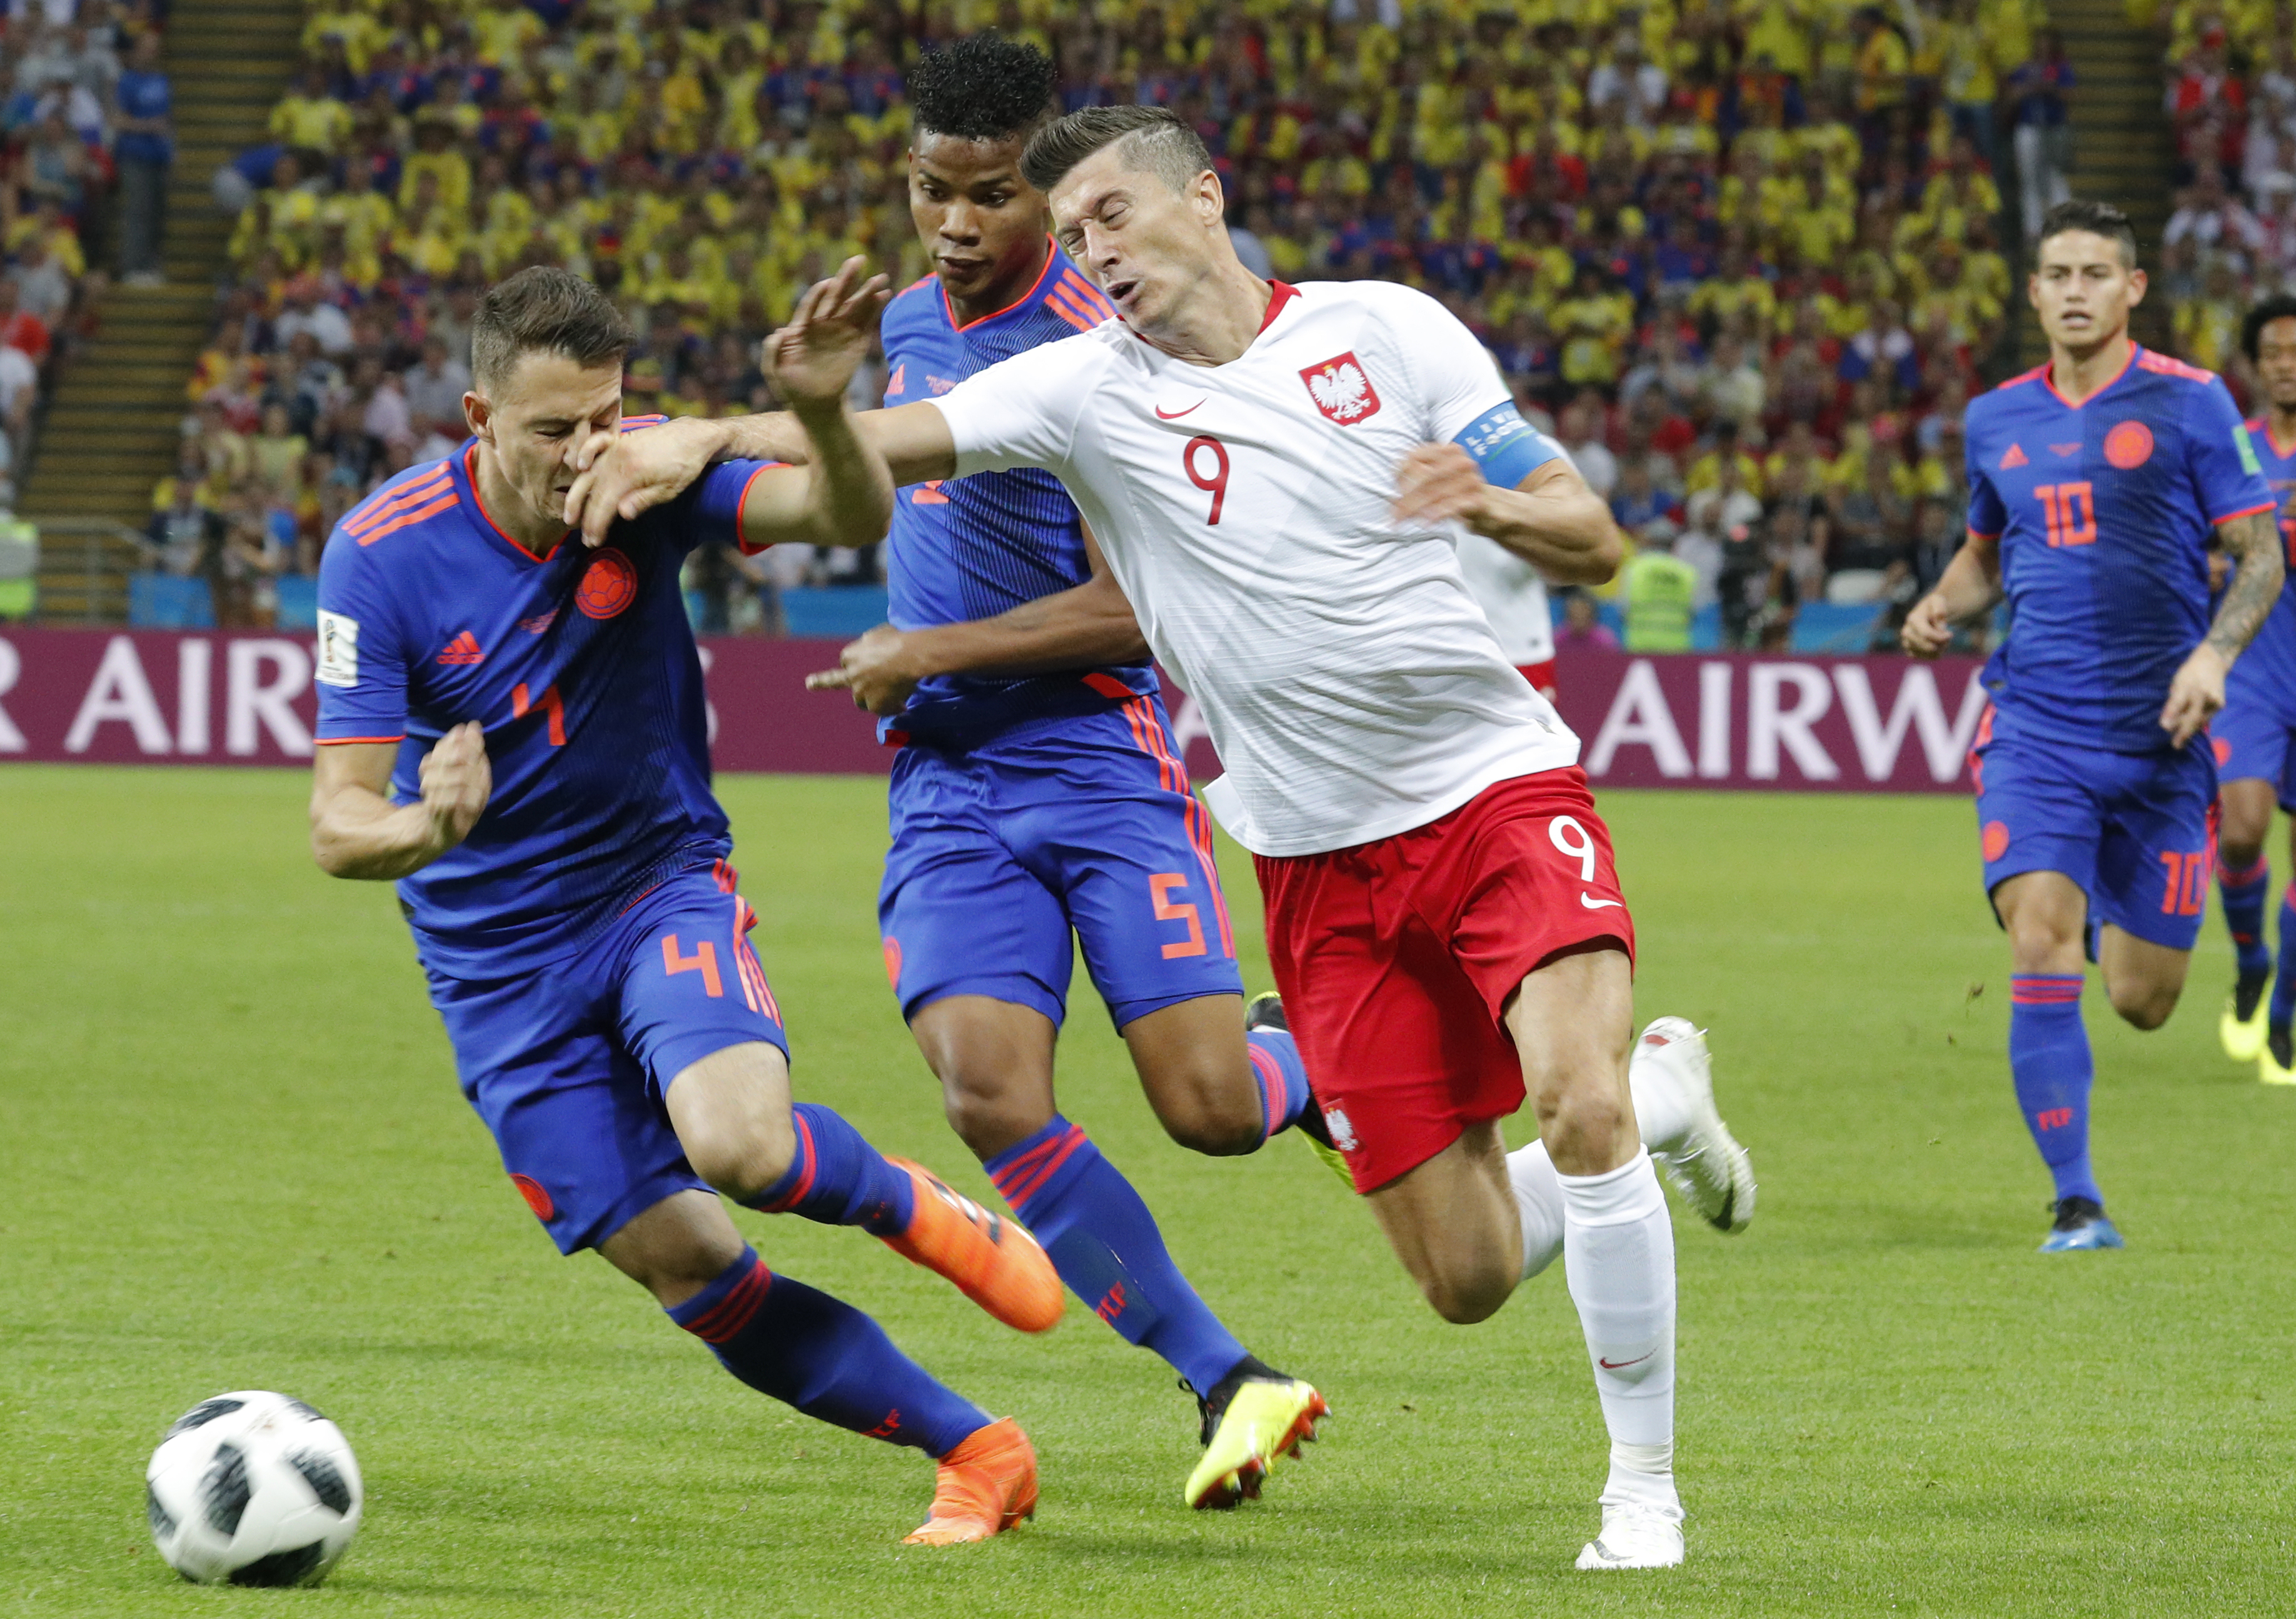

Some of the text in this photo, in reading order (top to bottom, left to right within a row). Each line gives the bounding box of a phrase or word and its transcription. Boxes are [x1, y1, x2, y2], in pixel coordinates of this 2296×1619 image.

[1183, 434, 1231, 526] 9
[2033, 481, 2098, 548] 10
[511, 682, 567, 747] 4
[1548, 814, 1596, 884] 9
[2160, 850, 2203, 915] 10
[1149, 873, 1207, 961] 5
[661, 932, 724, 998] 4
